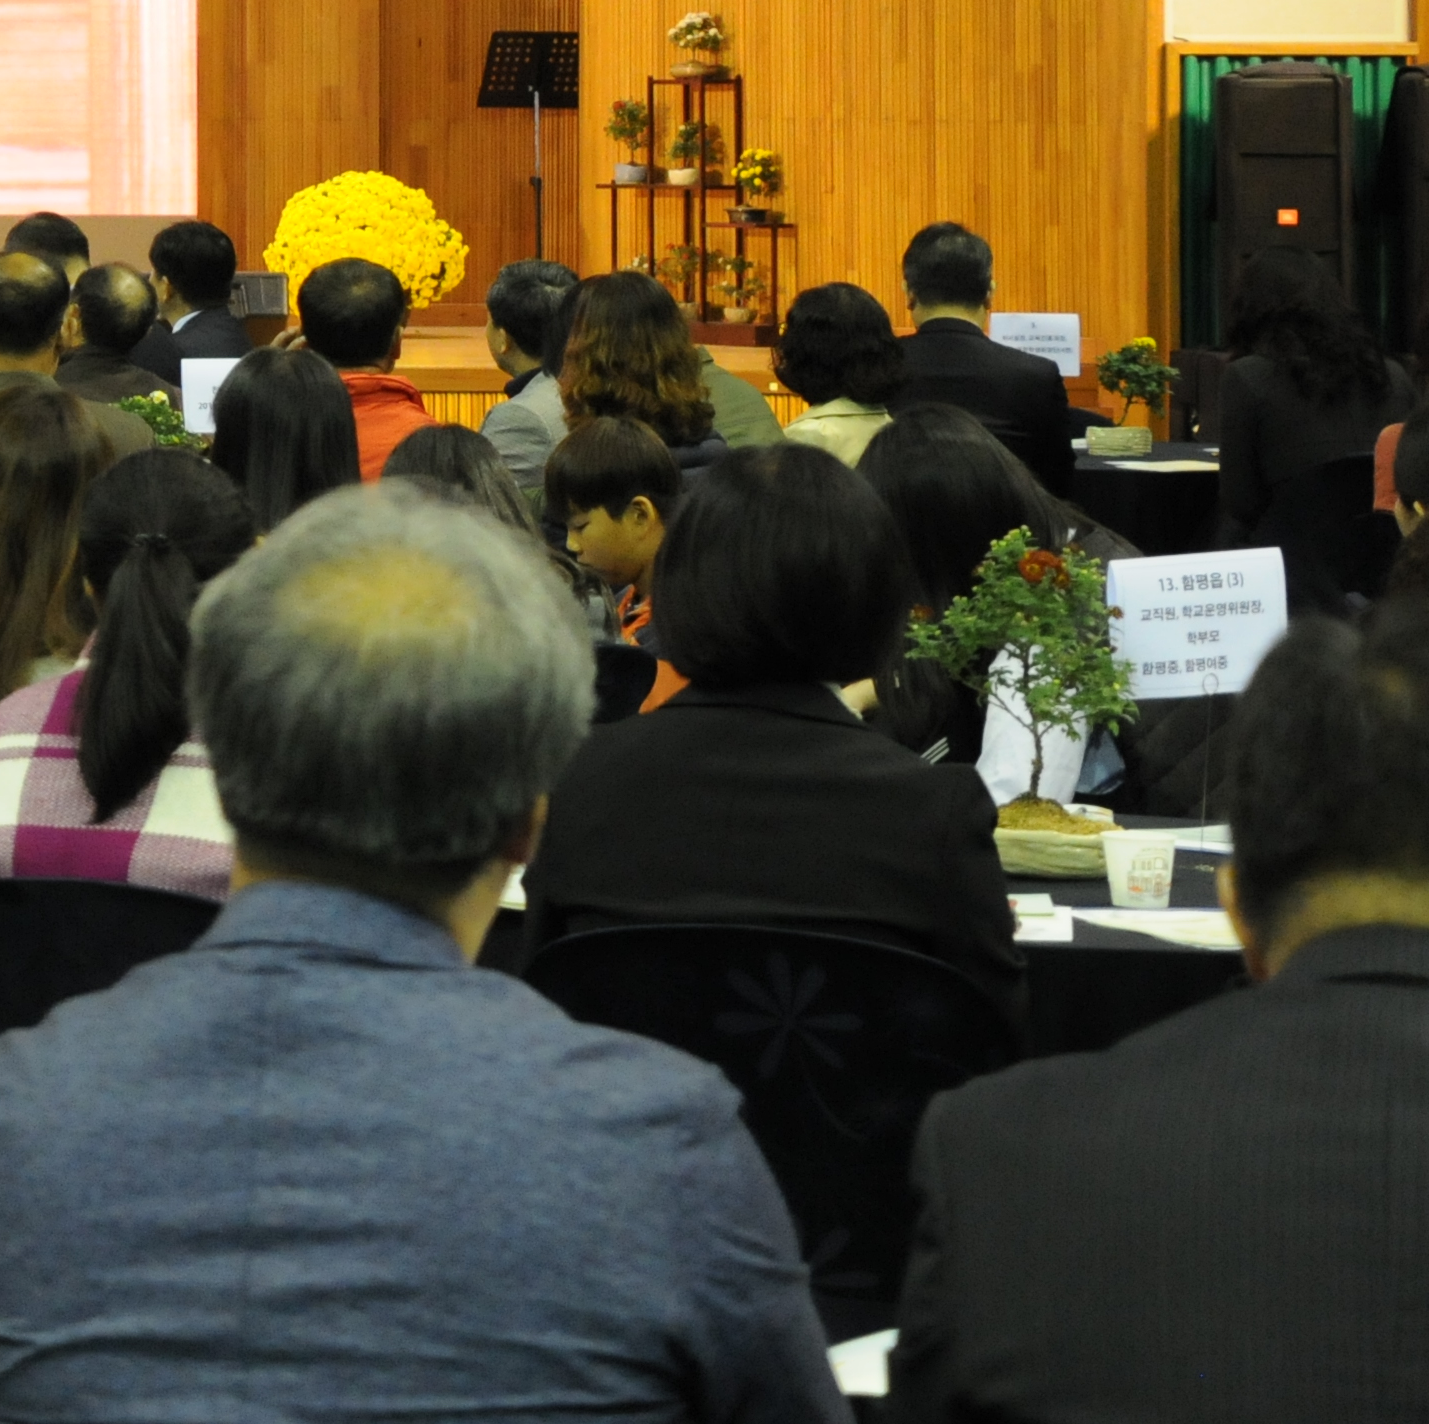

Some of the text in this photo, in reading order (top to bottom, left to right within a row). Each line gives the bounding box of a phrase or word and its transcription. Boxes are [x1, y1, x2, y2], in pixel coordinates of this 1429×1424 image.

[1158, 572, 1244, 592] 13. 함평읍 (3)
[1141, 600, 1265, 622] 교직원, 학교운영위원장,
[1187, 630, 1220, 645] 학부모
[1142, 655, 1228, 675] 함평중, 함평여중
